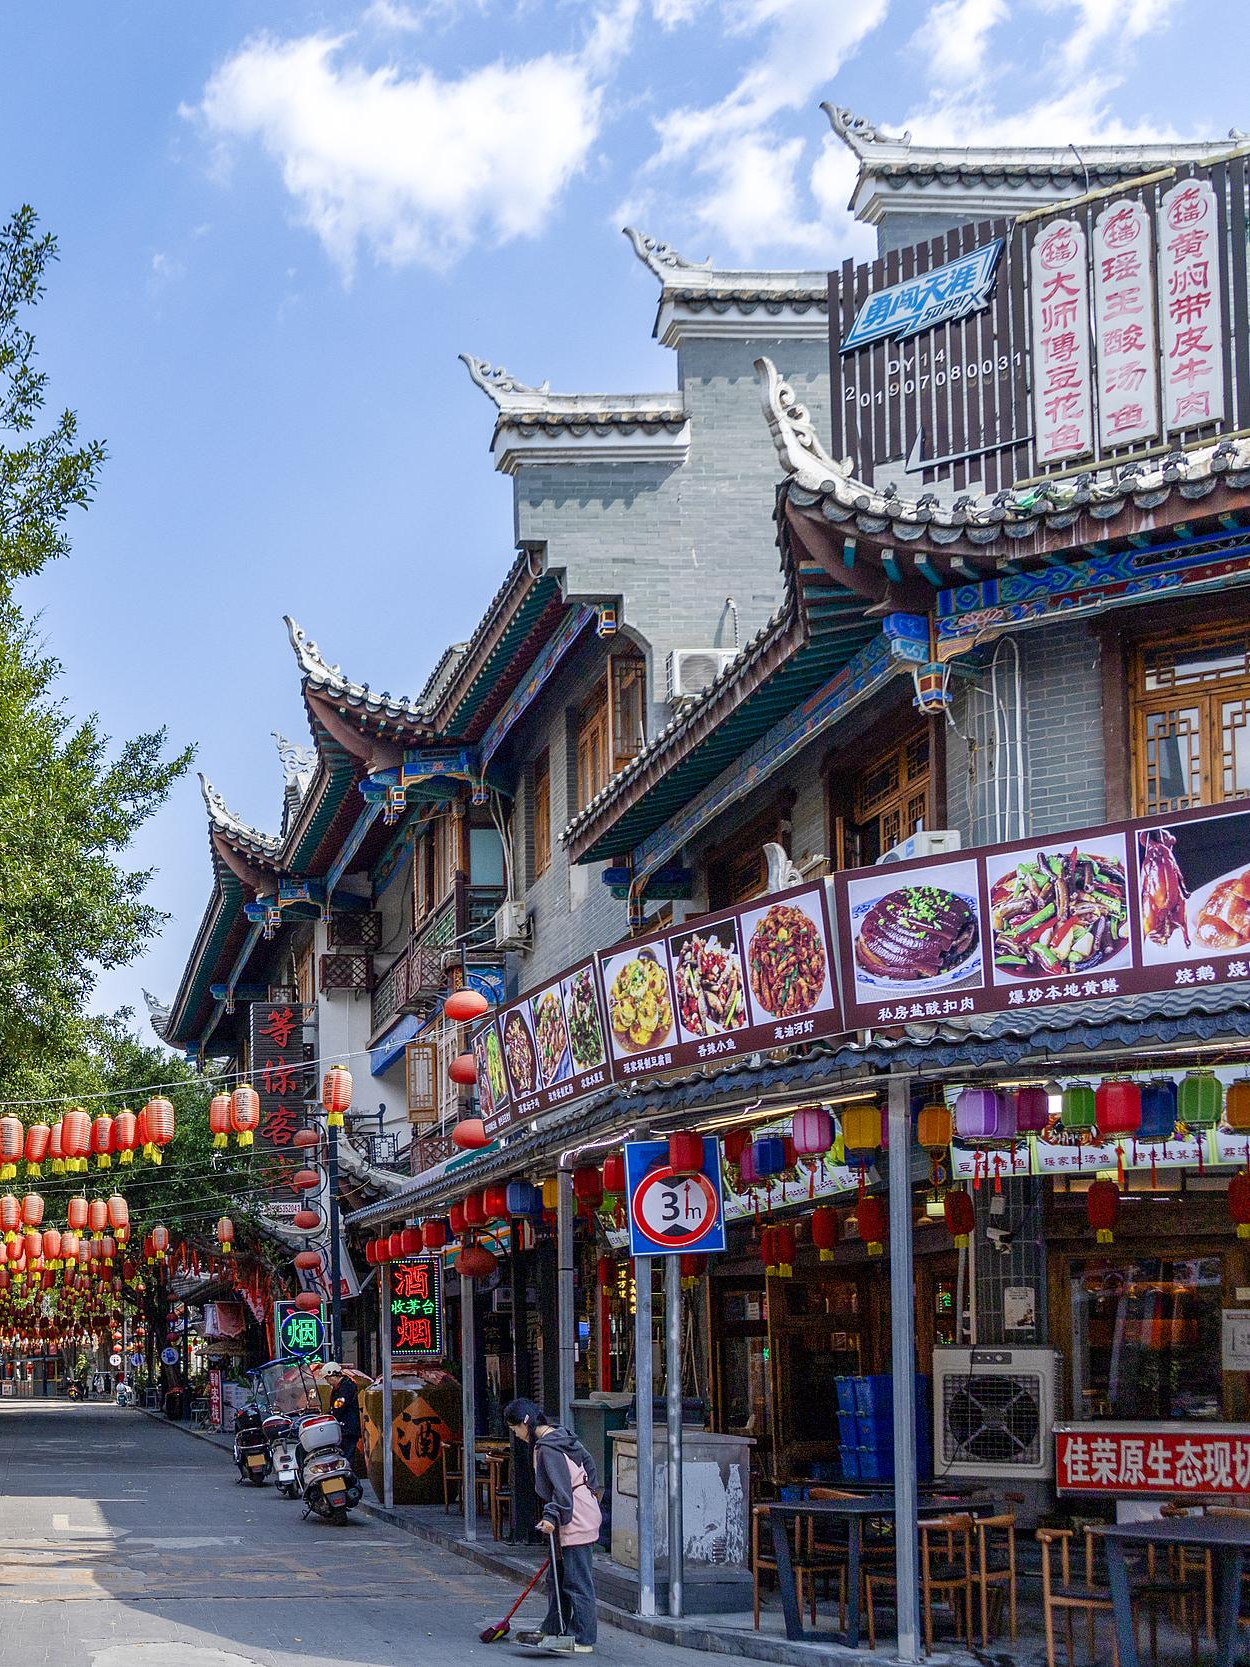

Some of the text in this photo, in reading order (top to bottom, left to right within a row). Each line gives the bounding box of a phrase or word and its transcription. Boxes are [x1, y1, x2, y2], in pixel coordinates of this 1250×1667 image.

[861, 260, 979, 330] 勇闯天涯
[1168, 230, 1214, 424] 黄焖带皮牛肉
[1102, 250, 1148, 437] 瑶王酸汤鱼
[888, 349, 947, 376] DY14
[845, 352, 1022, 408] 201907080031
[1174, 961, 1250, 985] 烧鹅 烧
[1008, 978, 1120, 1005] 爆炒本地黄鳝
[877, 997, 975, 1021] 私房盐酸扣肉
[774, 1020, 815, 1040] 葱油河虾
[697, 1038, 737, 1057] 香辣小鱼
[395, 1263, 429, 1299] 酒
[391, 1299, 435, 1315] 收茅台
[287, 1318, 318, 1349] 烟
[396, 1315, 431, 1349] 烟
[397, 1412, 441, 1460] 酒
[1063, 1436, 1250, 1489] 佳荣原生态现切
